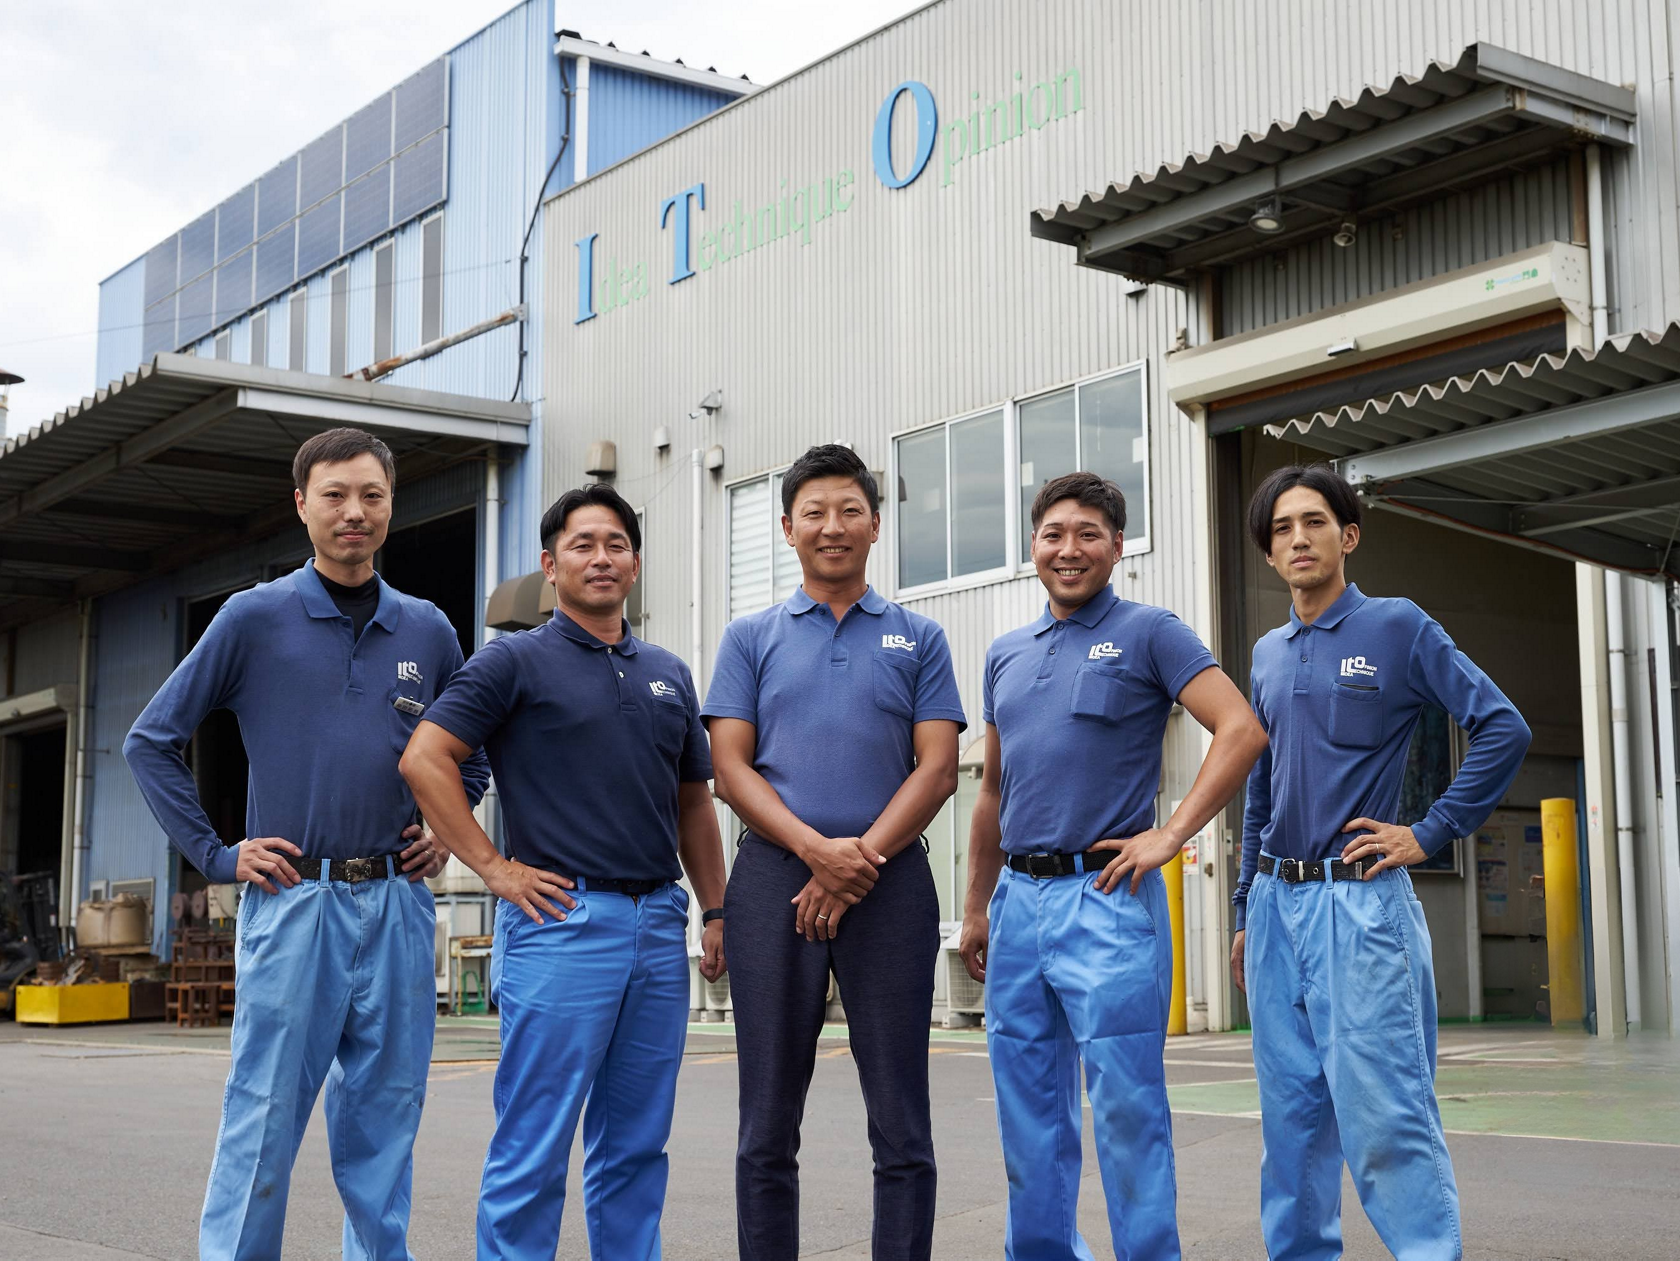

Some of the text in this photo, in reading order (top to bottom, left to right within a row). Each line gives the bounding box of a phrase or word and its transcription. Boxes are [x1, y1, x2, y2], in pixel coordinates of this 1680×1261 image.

[574, 67, 1085, 326] Idea Technique Opinion
